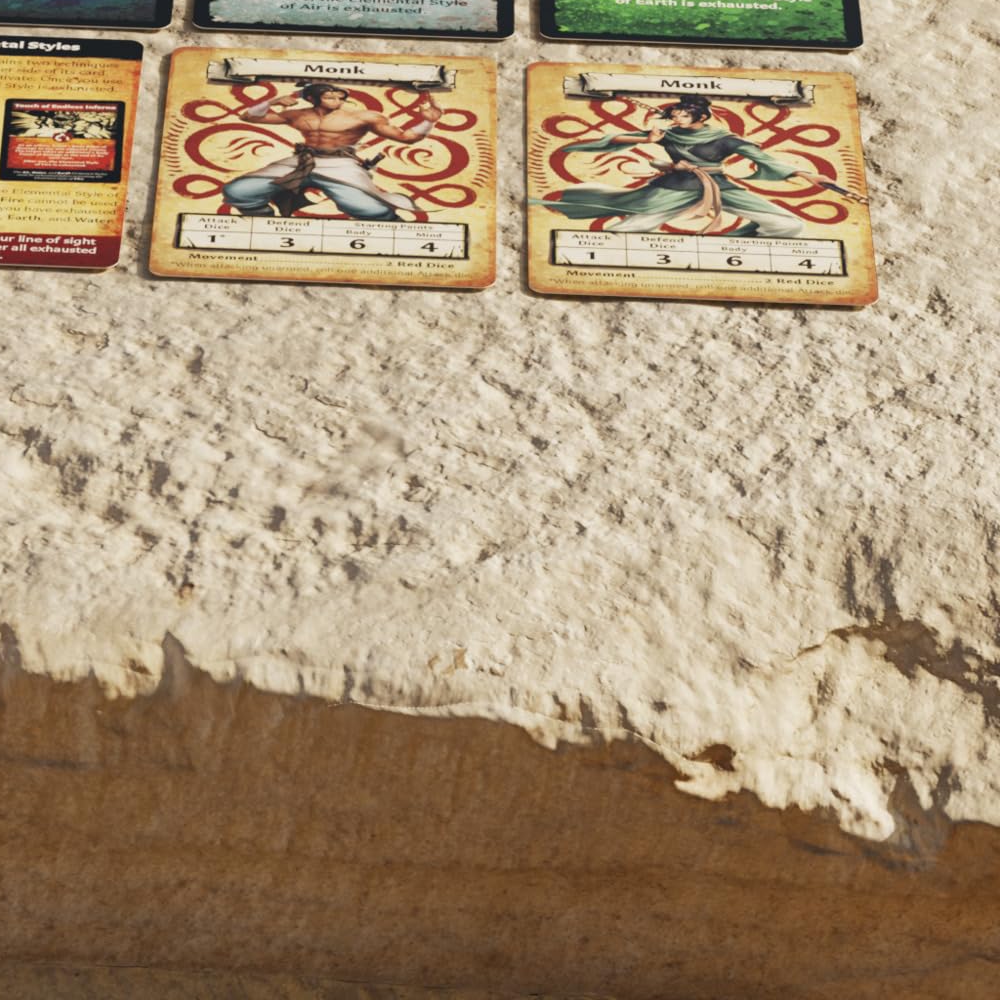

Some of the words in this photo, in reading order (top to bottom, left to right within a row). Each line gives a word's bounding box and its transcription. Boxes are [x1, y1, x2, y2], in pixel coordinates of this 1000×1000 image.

[681, 0, 695, 7] is
[698, 0, 783, 10] exhausted.
[27, 41, 81, 52] Styles
[304, 64, 365, 74] Monk
[661, 80, 722, 90] Monk
[200, 217, 237, 225] Attack
[354, 222, 398, 230] Starting
[17, 234, 43, 243] line
[45, 235, 61, 244] of
[63, 237, 97, 246] sight
[279, 237, 295, 248] 3
[349, 239, 366, 250] 6
[729, 239, 772, 247] Starting
[11, 243, 26, 252] all
[29, 245, 97, 255] exhausted
[420, 242, 438, 253] 4
[189, 253, 259, 262] Movement
[586, 252, 595, 260] 1
[656, 254, 671, 265] 3
[726, 255, 743, 267] 6
[798, 259, 816, 269] 4
[566, 270, 636, 278] Movement
